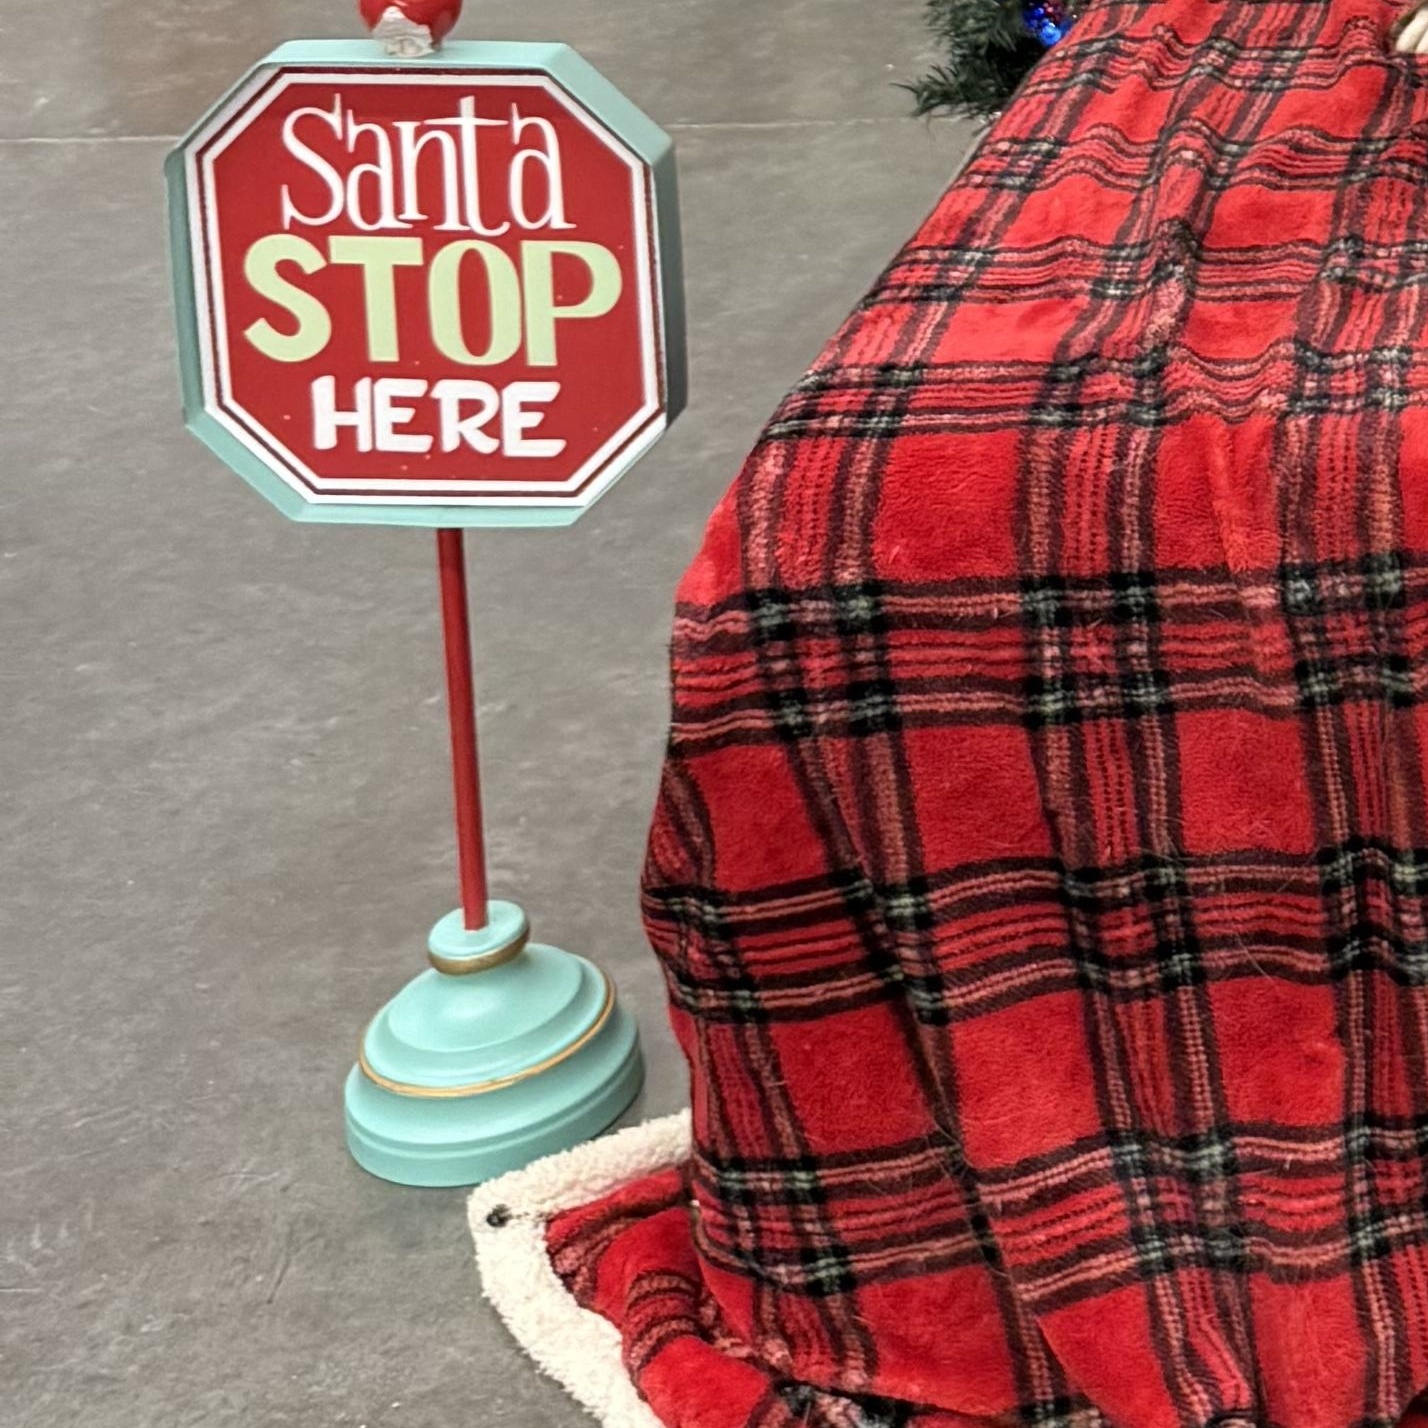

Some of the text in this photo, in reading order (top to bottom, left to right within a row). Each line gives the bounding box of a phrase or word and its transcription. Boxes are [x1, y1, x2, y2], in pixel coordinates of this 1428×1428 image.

[281, 93, 576, 236] Santa
[243, 234, 623, 367] STOP
[310, 375, 567, 458] HERE
